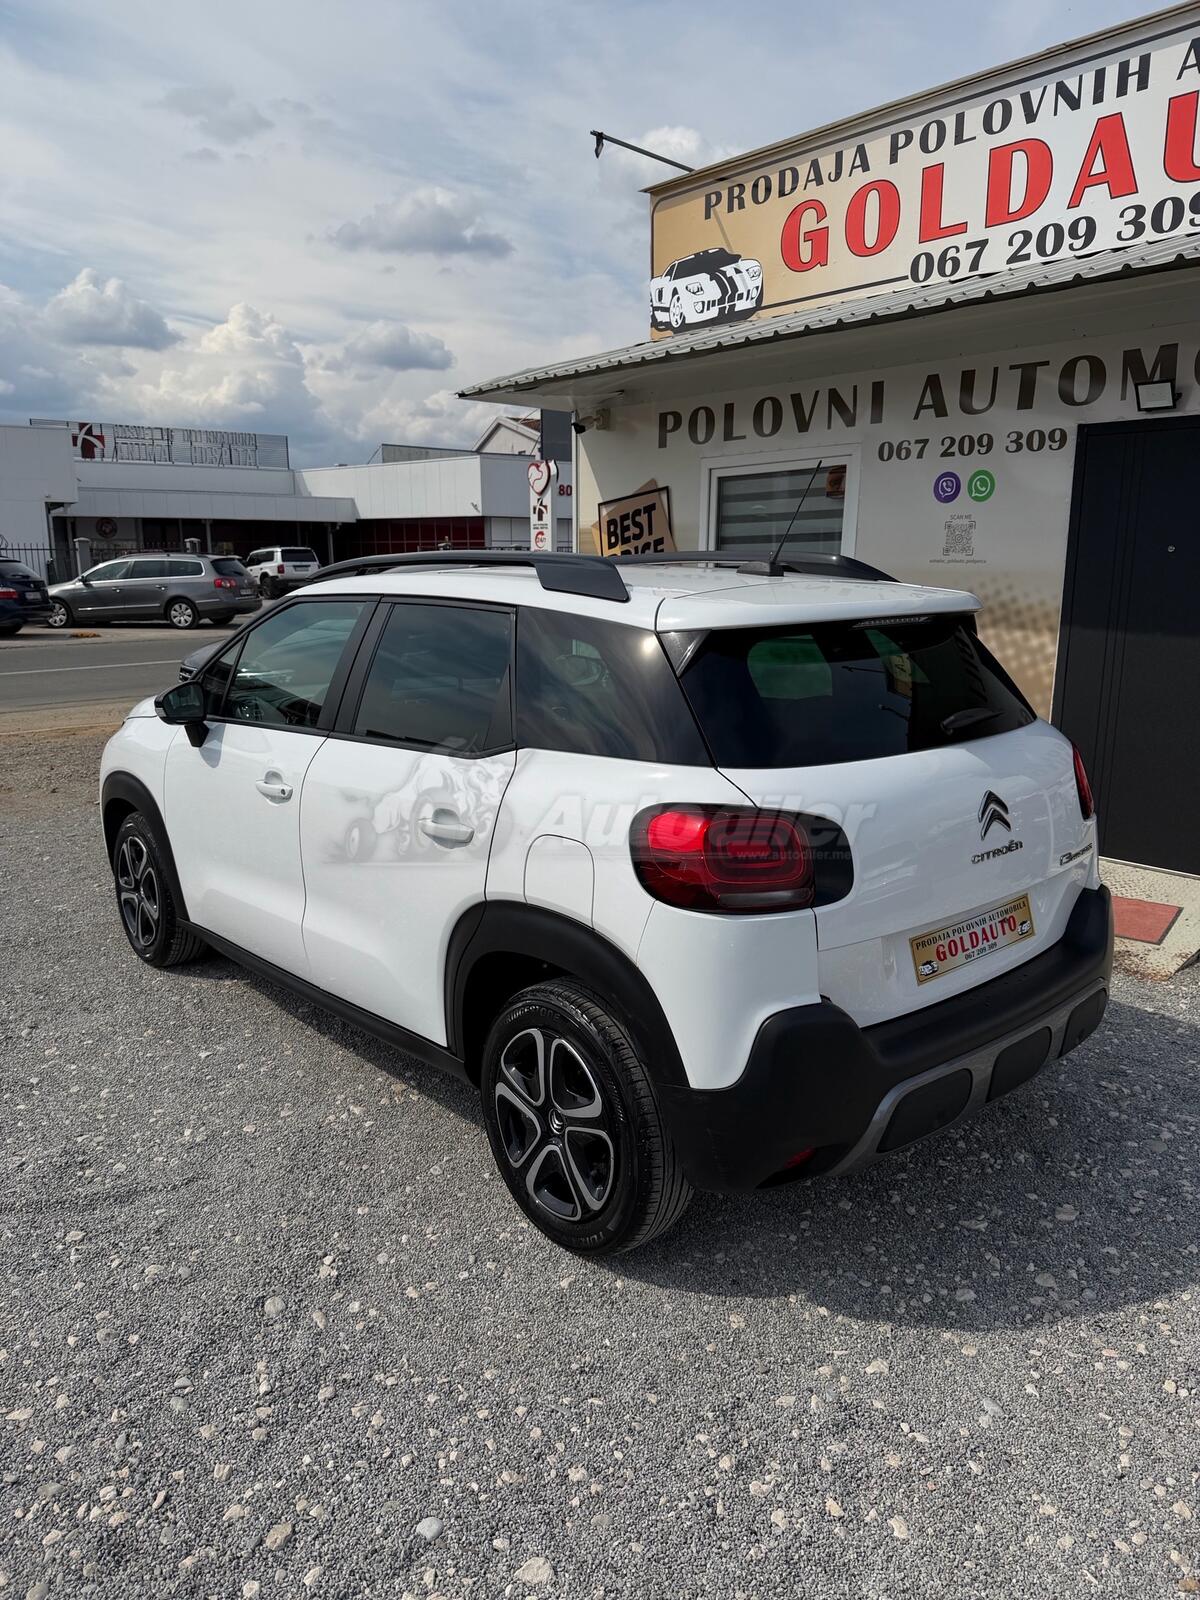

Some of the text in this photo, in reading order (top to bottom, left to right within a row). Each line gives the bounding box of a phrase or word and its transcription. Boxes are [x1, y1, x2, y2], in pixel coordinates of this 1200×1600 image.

[704, 143, 872, 221] PRODAJA
[889, 52, 1151, 165] POLOVNIH
[909, 239, 989, 284] 067
[1006, 215, 1097, 264] 209
[657, 343, 1200, 449] POLOVNI AUTOM
[877, 427, 1069, 463] 067 209 309
[606, 503, 657, 550] BEST
[915, 900, 1027, 951] PRODAJA POLOVNIH AUTOMOBILA
[935, 914, 1017, 962] GOLDAUTO
